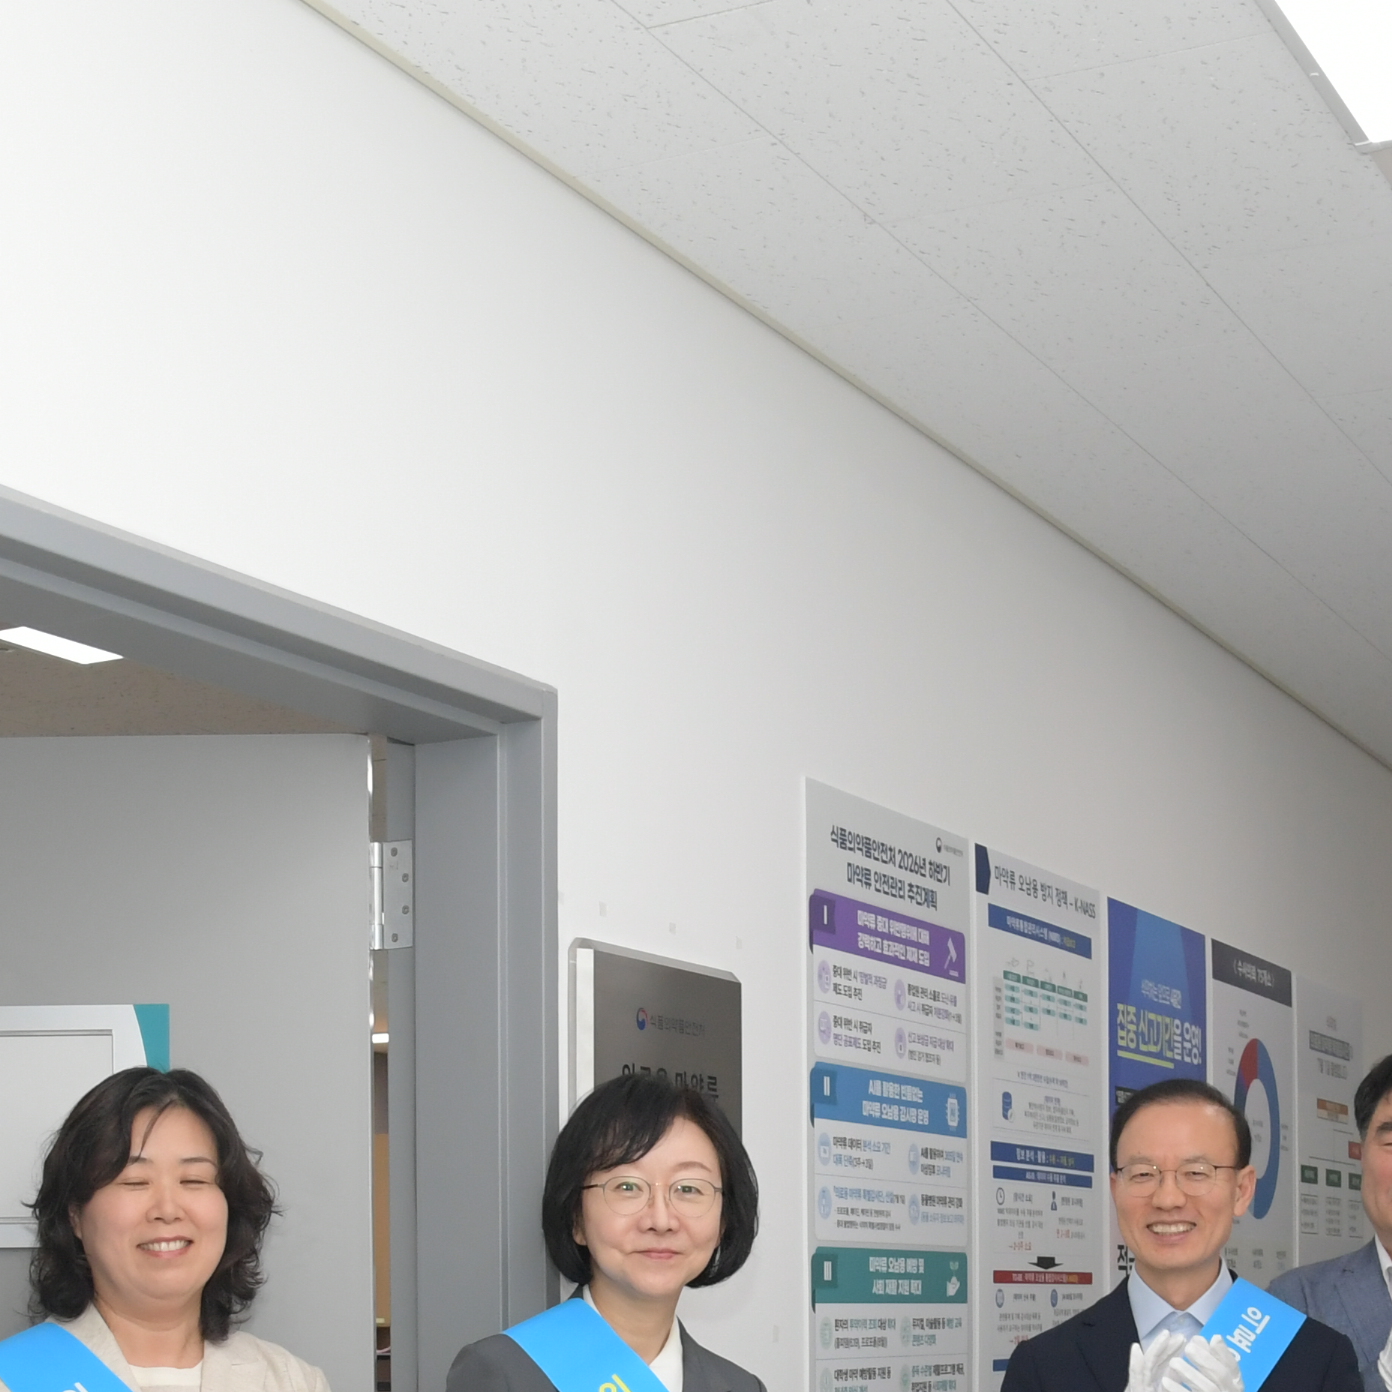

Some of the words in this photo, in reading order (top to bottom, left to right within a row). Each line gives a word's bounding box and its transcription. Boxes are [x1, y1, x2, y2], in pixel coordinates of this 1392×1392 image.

[830, 824, 896, 868] 식품의약품안전처
[897, 849, 927, 879] 2026년
[928, 859, 951, 887] 하반기
[846, 862, 872, 891] 마약류
[873, 870, 906, 901] 안전관리
[907, 882, 938, 912] 추진계획
[993, 863, 1016, 892] 마약류
[1017, 872, 1038, 900] 오남용
[1039, 880, 1053, 906] 방지
[1055, 886, 1068, 911] 정책
[1074, 895, 1096, 920] K-NASS
[650, 1015, 705, 1037] 식품의약품안전처
[1116, 1000, 1137, 1050] 집중
[1138, 1007, 1182, 1062] 신고기간을
[1182, 1020, 1202, 1067] 운영!
[861, 1100, 880, 1119] 마약류
[881, 1103, 899, 1121] 오남용
[869, 1256, 887, 1273] 마약류
[887, 1256, 905, 1273] 오남용
